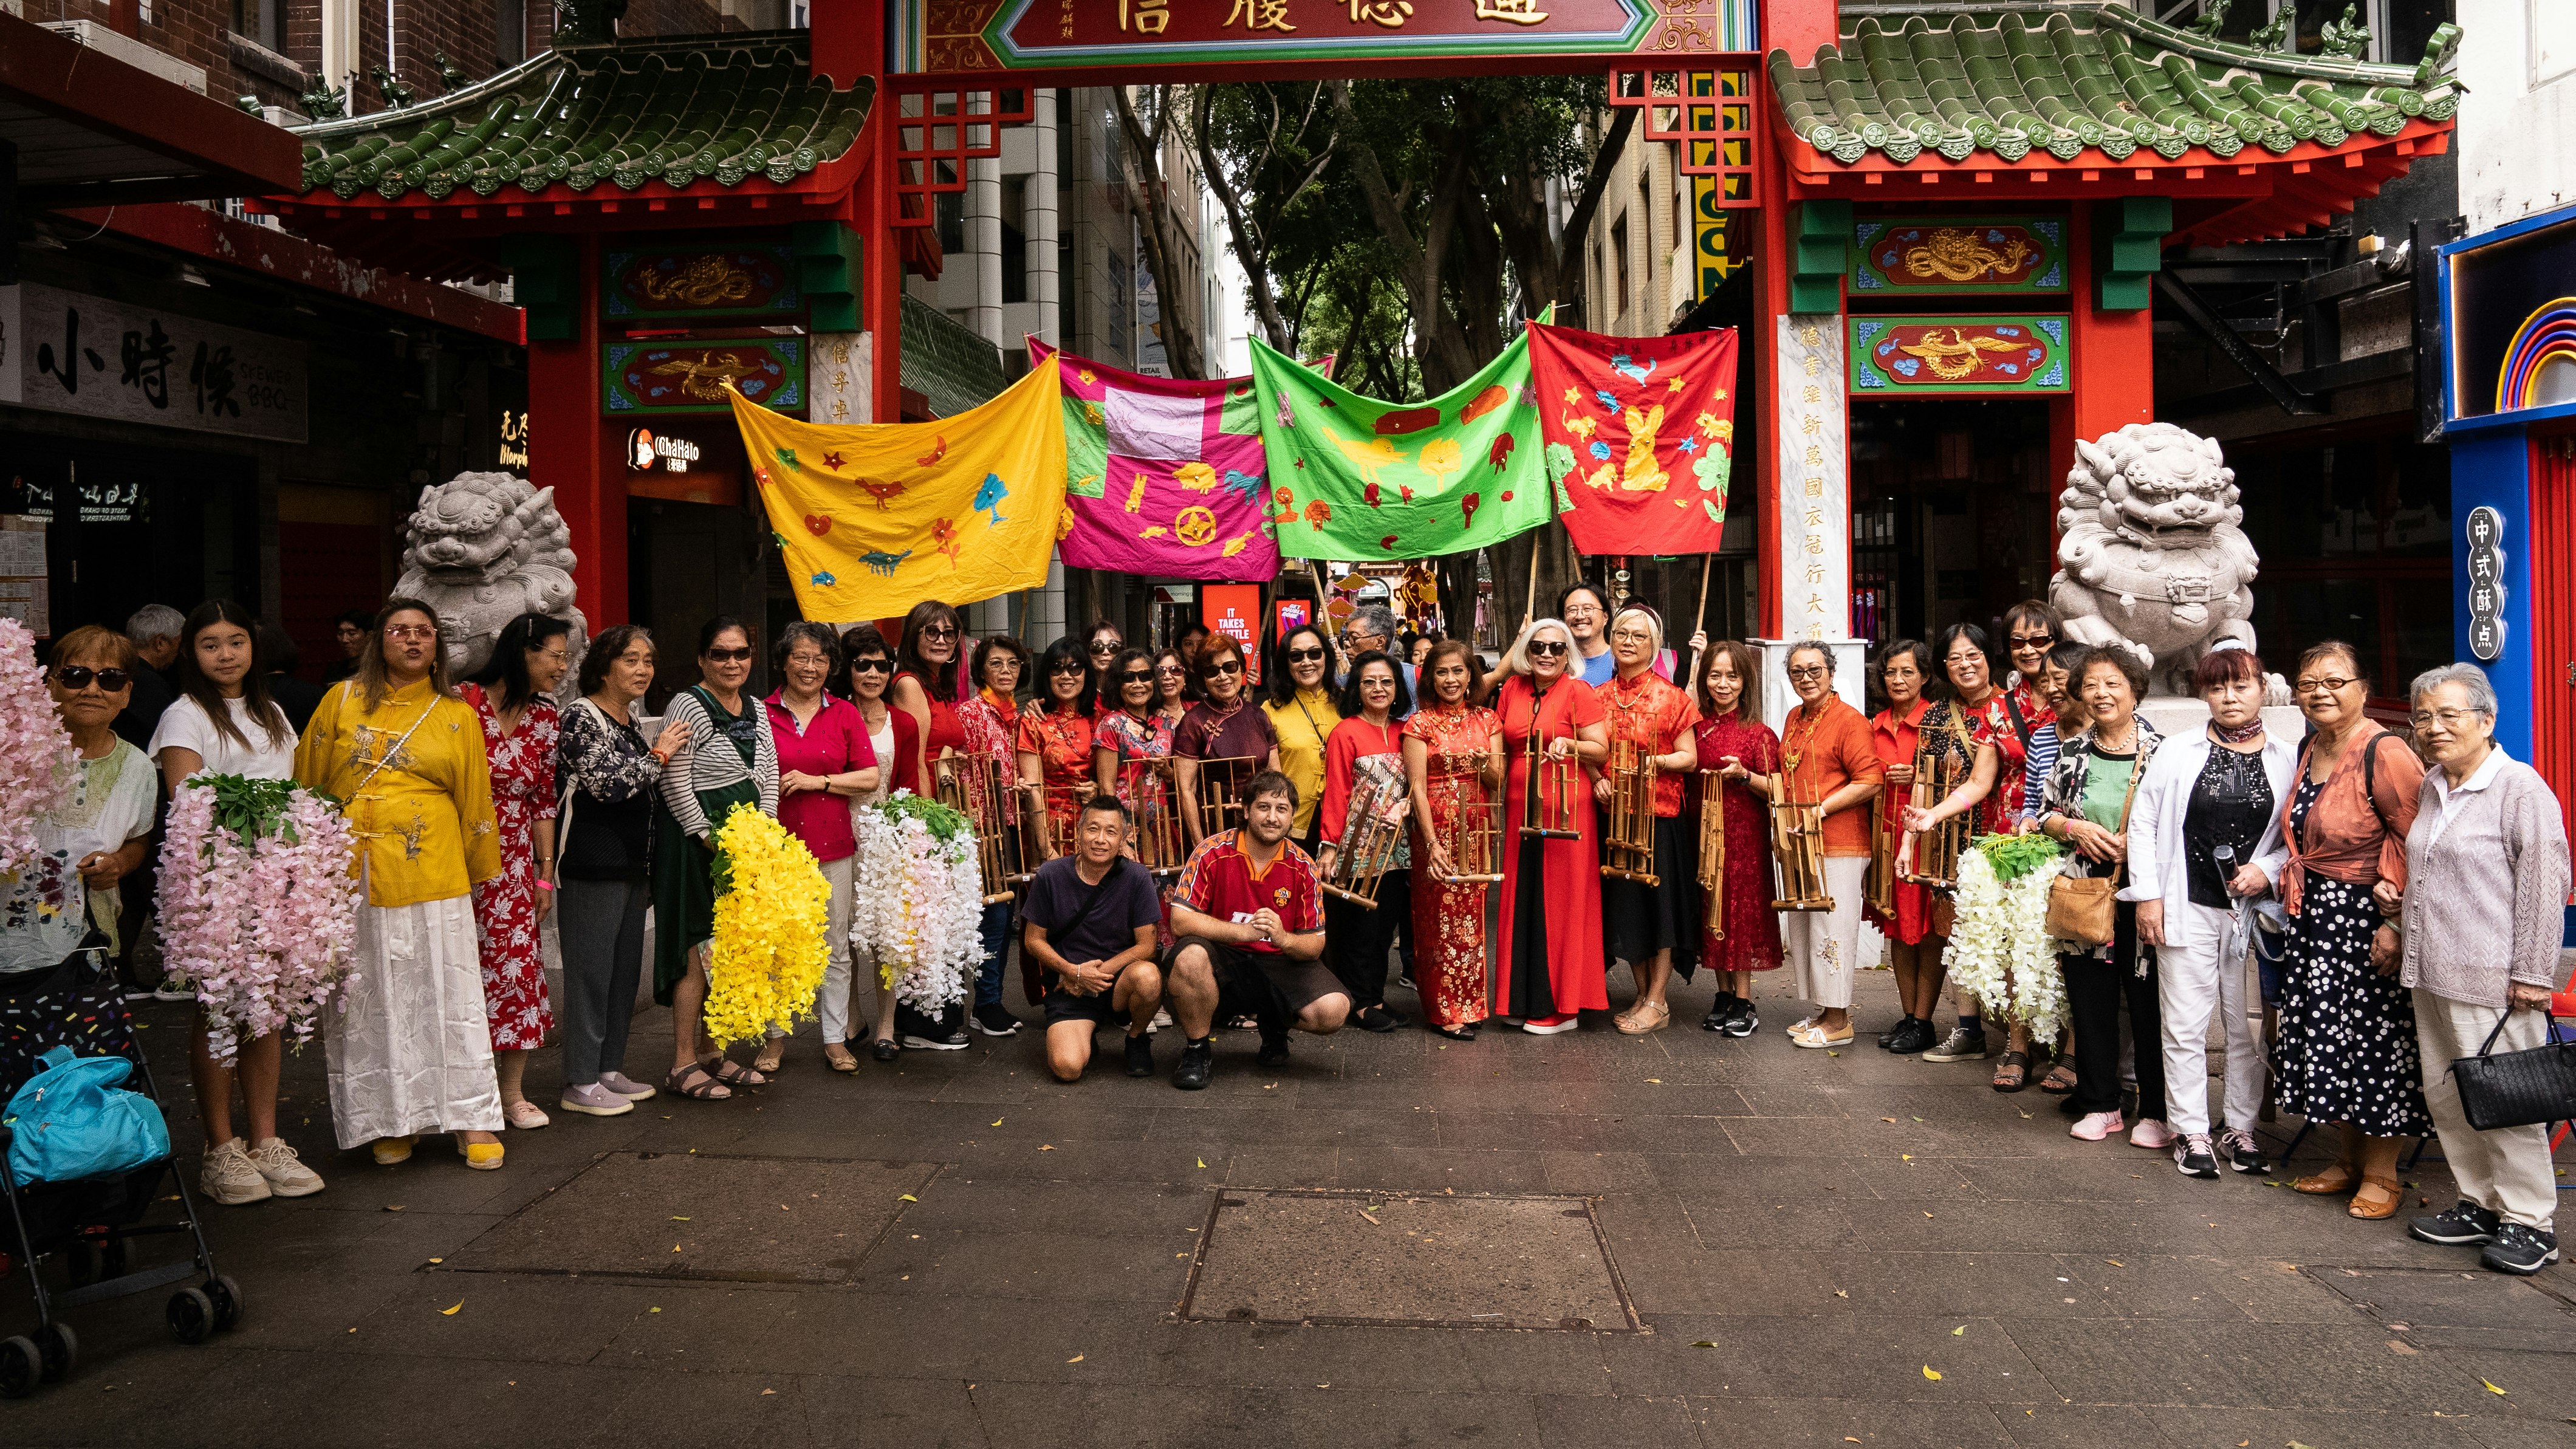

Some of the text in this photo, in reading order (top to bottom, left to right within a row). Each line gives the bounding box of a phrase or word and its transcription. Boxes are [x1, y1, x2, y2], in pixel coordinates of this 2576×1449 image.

[247, 383, 288, 411] BBQ
[656, 436, 699, 461] ChaHalo
[2475, 520, 2492, 648] 中式酥点
[1218, 618, 1245, 629] TAKES
[1227, 608, 1235, 618] IT
